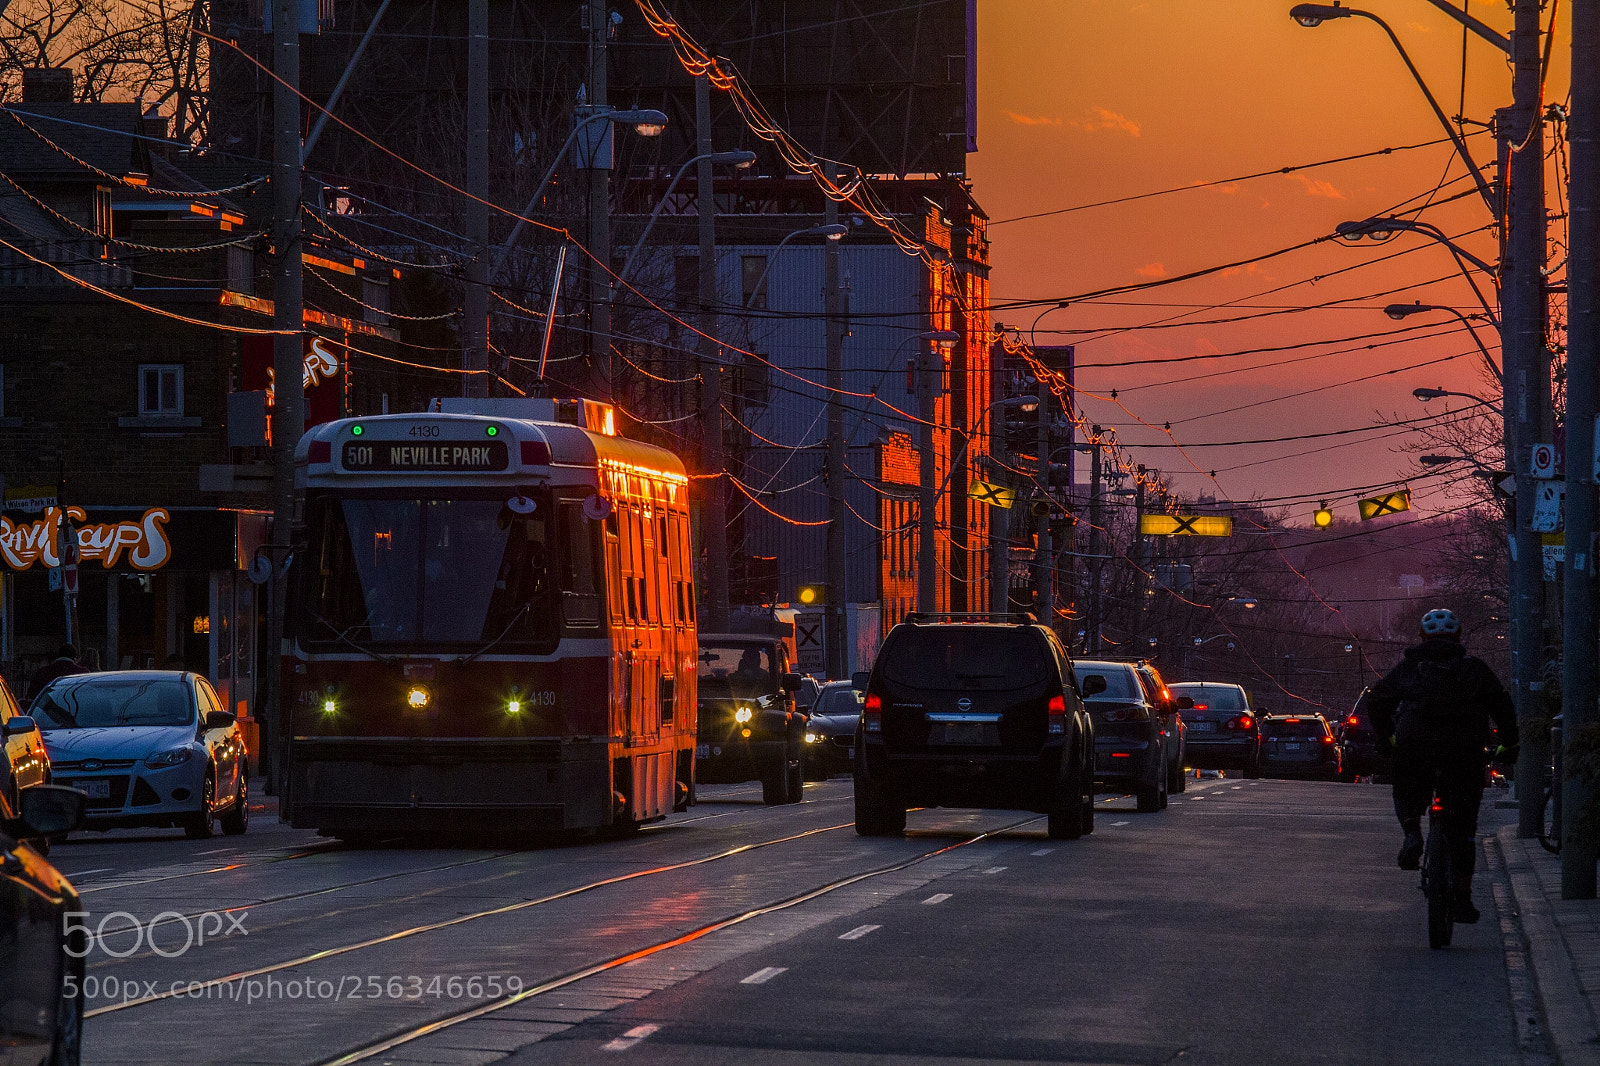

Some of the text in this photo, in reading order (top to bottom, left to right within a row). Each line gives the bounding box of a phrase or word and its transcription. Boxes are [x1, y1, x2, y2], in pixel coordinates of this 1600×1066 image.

[409, 426, 440, 437] 4130
[348, 447, 491, 465] 501 NEVILLE PARK
[7, 500, 29, 509] Wilson
[30, 498, 45, 506] Park
[529, 691, 556, 706] 4130
